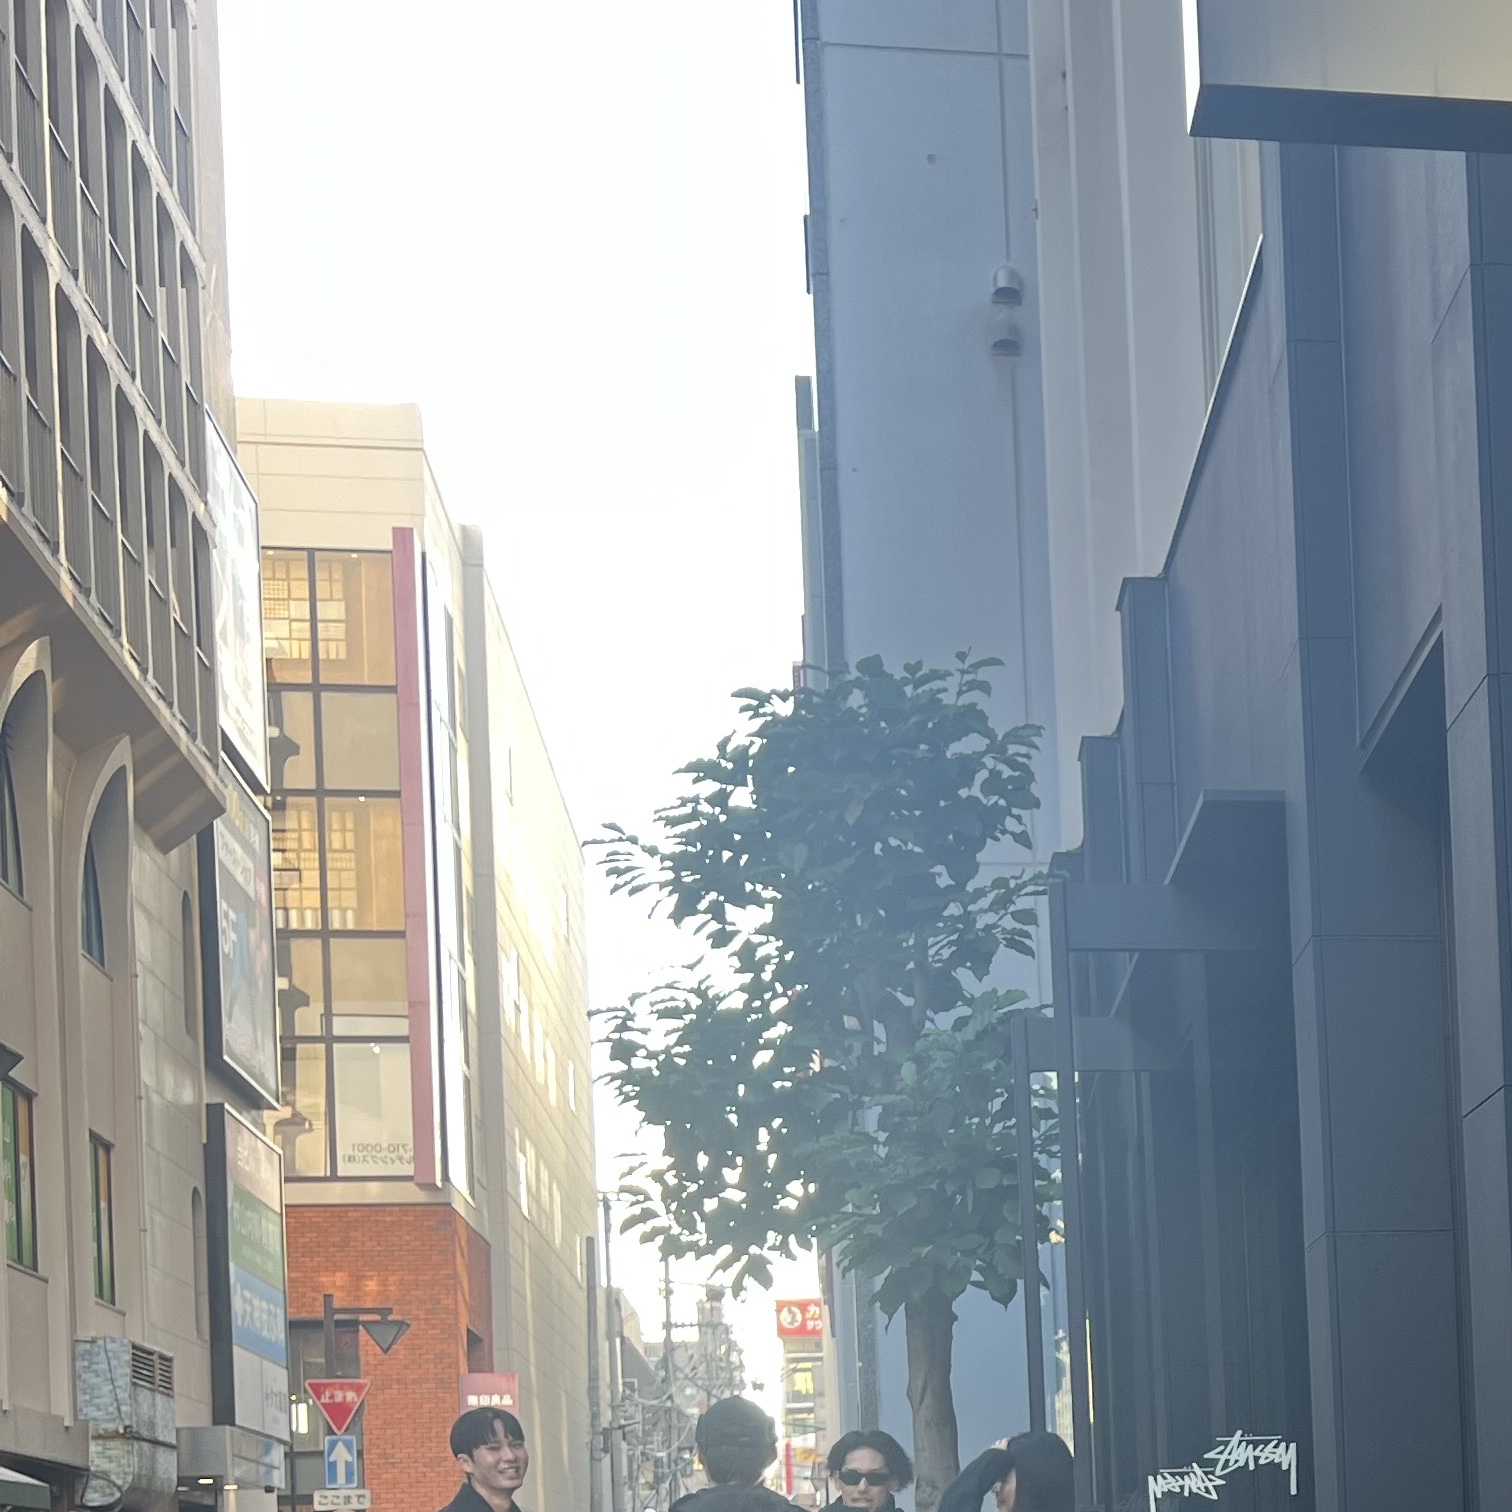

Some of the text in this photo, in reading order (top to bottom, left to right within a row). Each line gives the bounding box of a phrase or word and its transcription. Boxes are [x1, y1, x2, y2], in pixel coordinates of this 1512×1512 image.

[220, 899, 239, 959] 5F
[320, 1391, 358, 1404] 止まれ
[318, 1493, 366, 1506] ここまで
